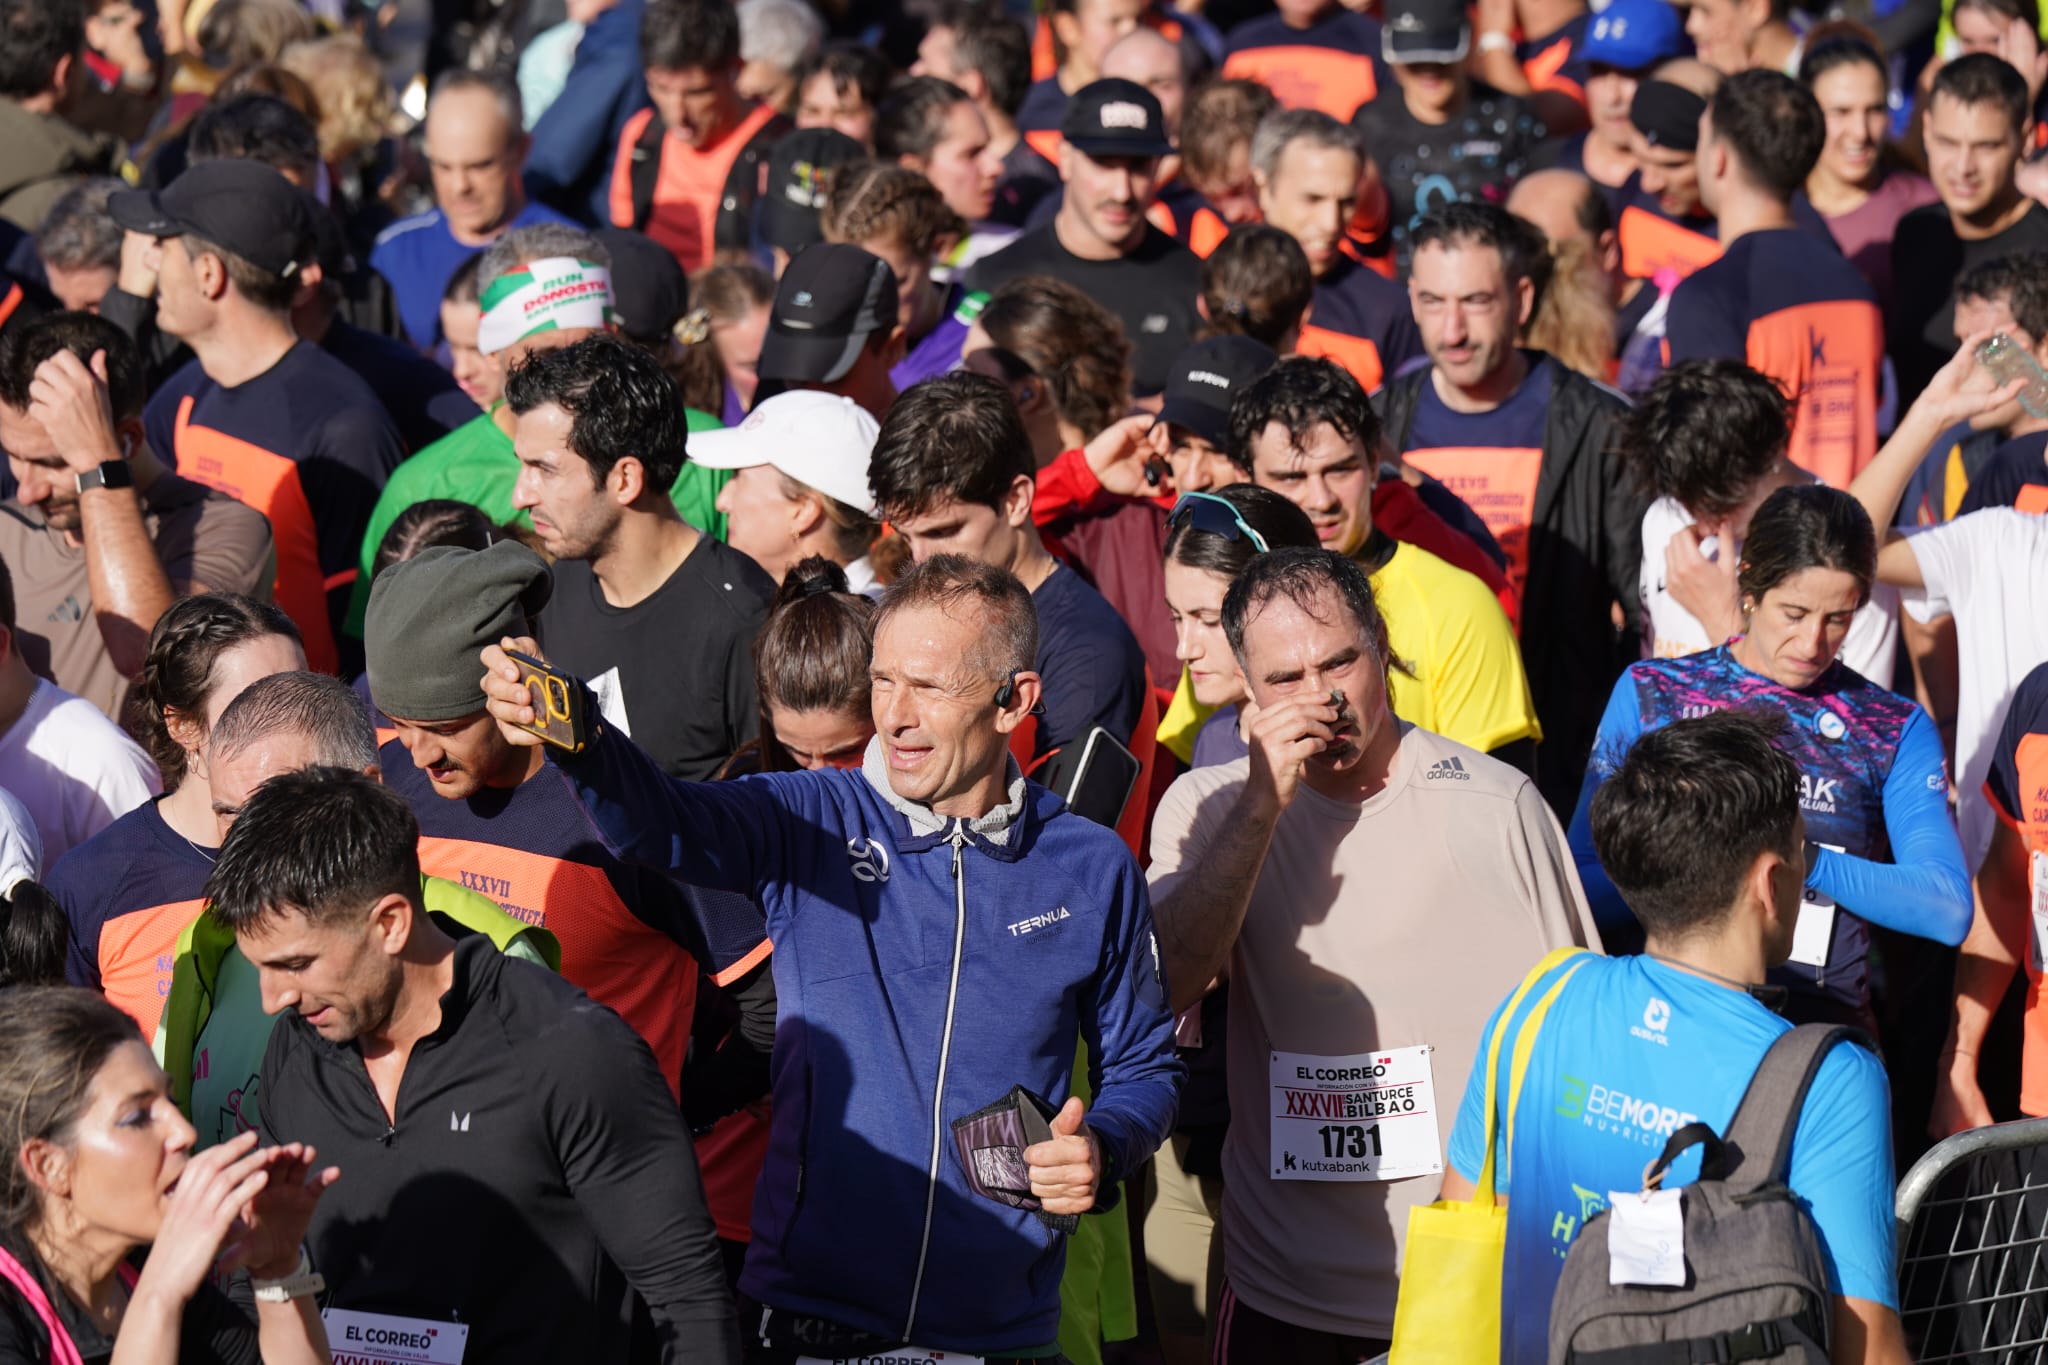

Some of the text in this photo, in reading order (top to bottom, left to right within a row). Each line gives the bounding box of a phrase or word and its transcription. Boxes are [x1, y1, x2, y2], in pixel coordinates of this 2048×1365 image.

[543, 273, 584, 291] RUN
[1427, 768, 1471, 780] adidas
[1799, 798, 1836, 814] KLUBA
[460, 870, 511, 898] XXXVII
[1008, 906, 1071, 936] TERNUA
[1296, 1065, 1386, 1081] EL CORREO
[1346, 1087, 1414, 1104] SANTURCE
[1347, 1099, 1416, 1118] BILBAO
[1318, 1124, 1383, 1158] 1731
[1302, 1160, 1371, 1172] kutxabank
[346, 1325, 431, 1349] EL CORREO
